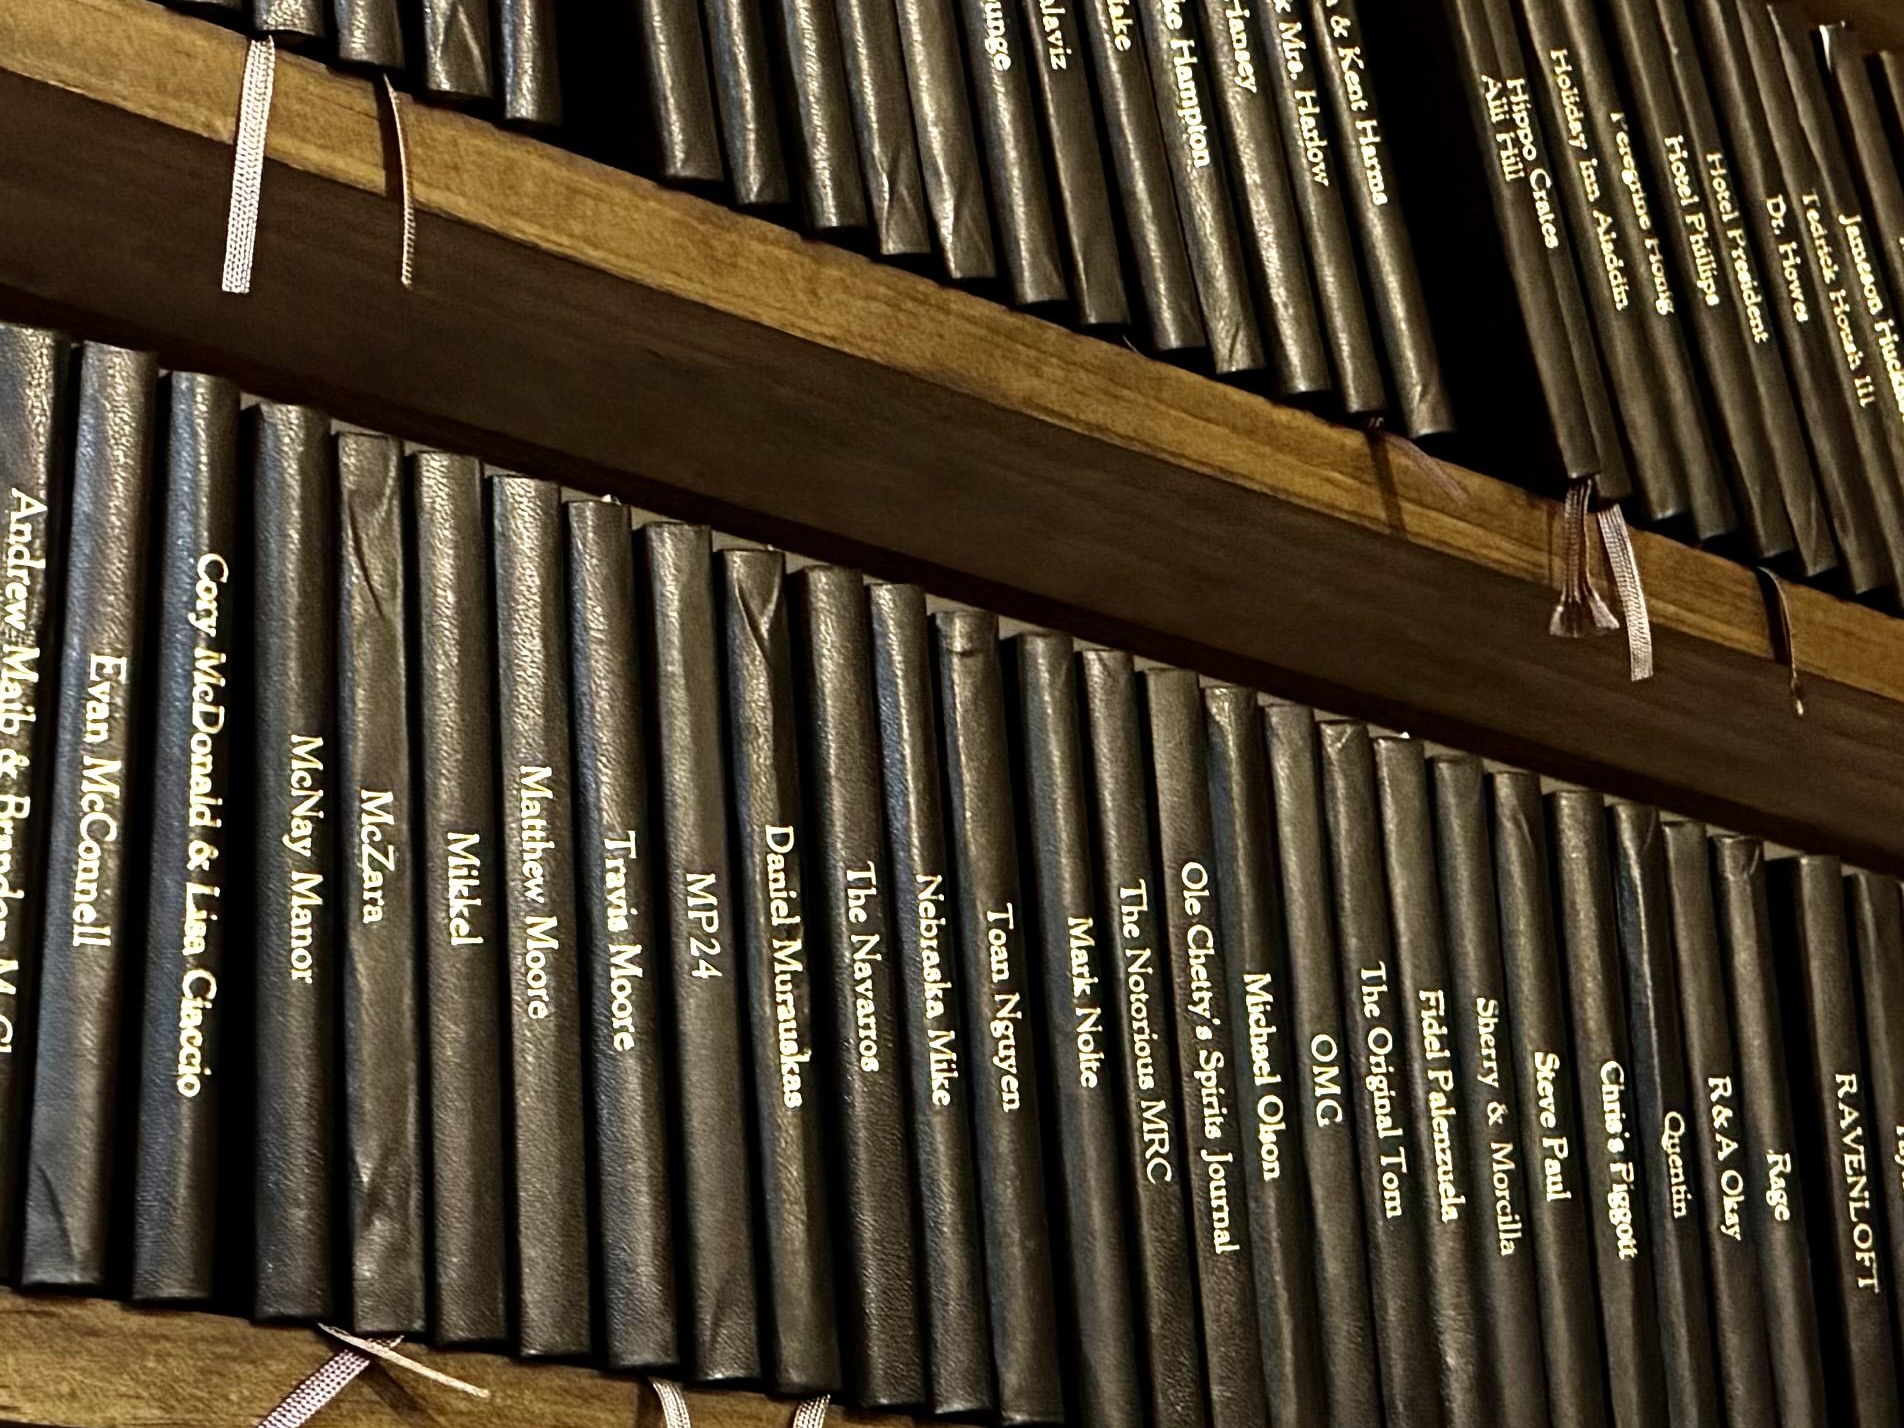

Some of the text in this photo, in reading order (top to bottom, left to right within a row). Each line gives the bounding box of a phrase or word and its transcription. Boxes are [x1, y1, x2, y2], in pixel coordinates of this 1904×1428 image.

[1705, 151, 1769, 344] Hotel President
[1765, 193, 1809, 323] Dr. Howes
[281, 733, 325, 985] McNay Manor
[355, 788, 396, 924] McZara
[444, 831, 484, 946] Mikkel
[519, 764, 559, 1019] Matthew Moore
[1180, 860, 1210, 916] Ole
[764, 823, 812, 1109] Daniel Murauskas
[845, 859, 882, 1072] The Navarros
[1066, 915, 1105, 1088] Mark Nolte
[1118, 877, 1172, 1185] The Notorious MRC
[1192, 1048, 1226, 1140] Spirits
[1309, 1032, 1343, 1128] OMG
[1359, 959, 1408, 1219] The Original Tom
[1417, 988, 1466, 1224] Fidel Palenzuela
[1533, 1050, 1572, 1203] Steve Paul
[1199, 1148, 1240, 1255] Journal
[1660, 1110, 1687, 1219] Quentin
[1764, 1147, 1792, 1221] Rage
[1834, 1072, 1879, 1293] RAVENLOFT
